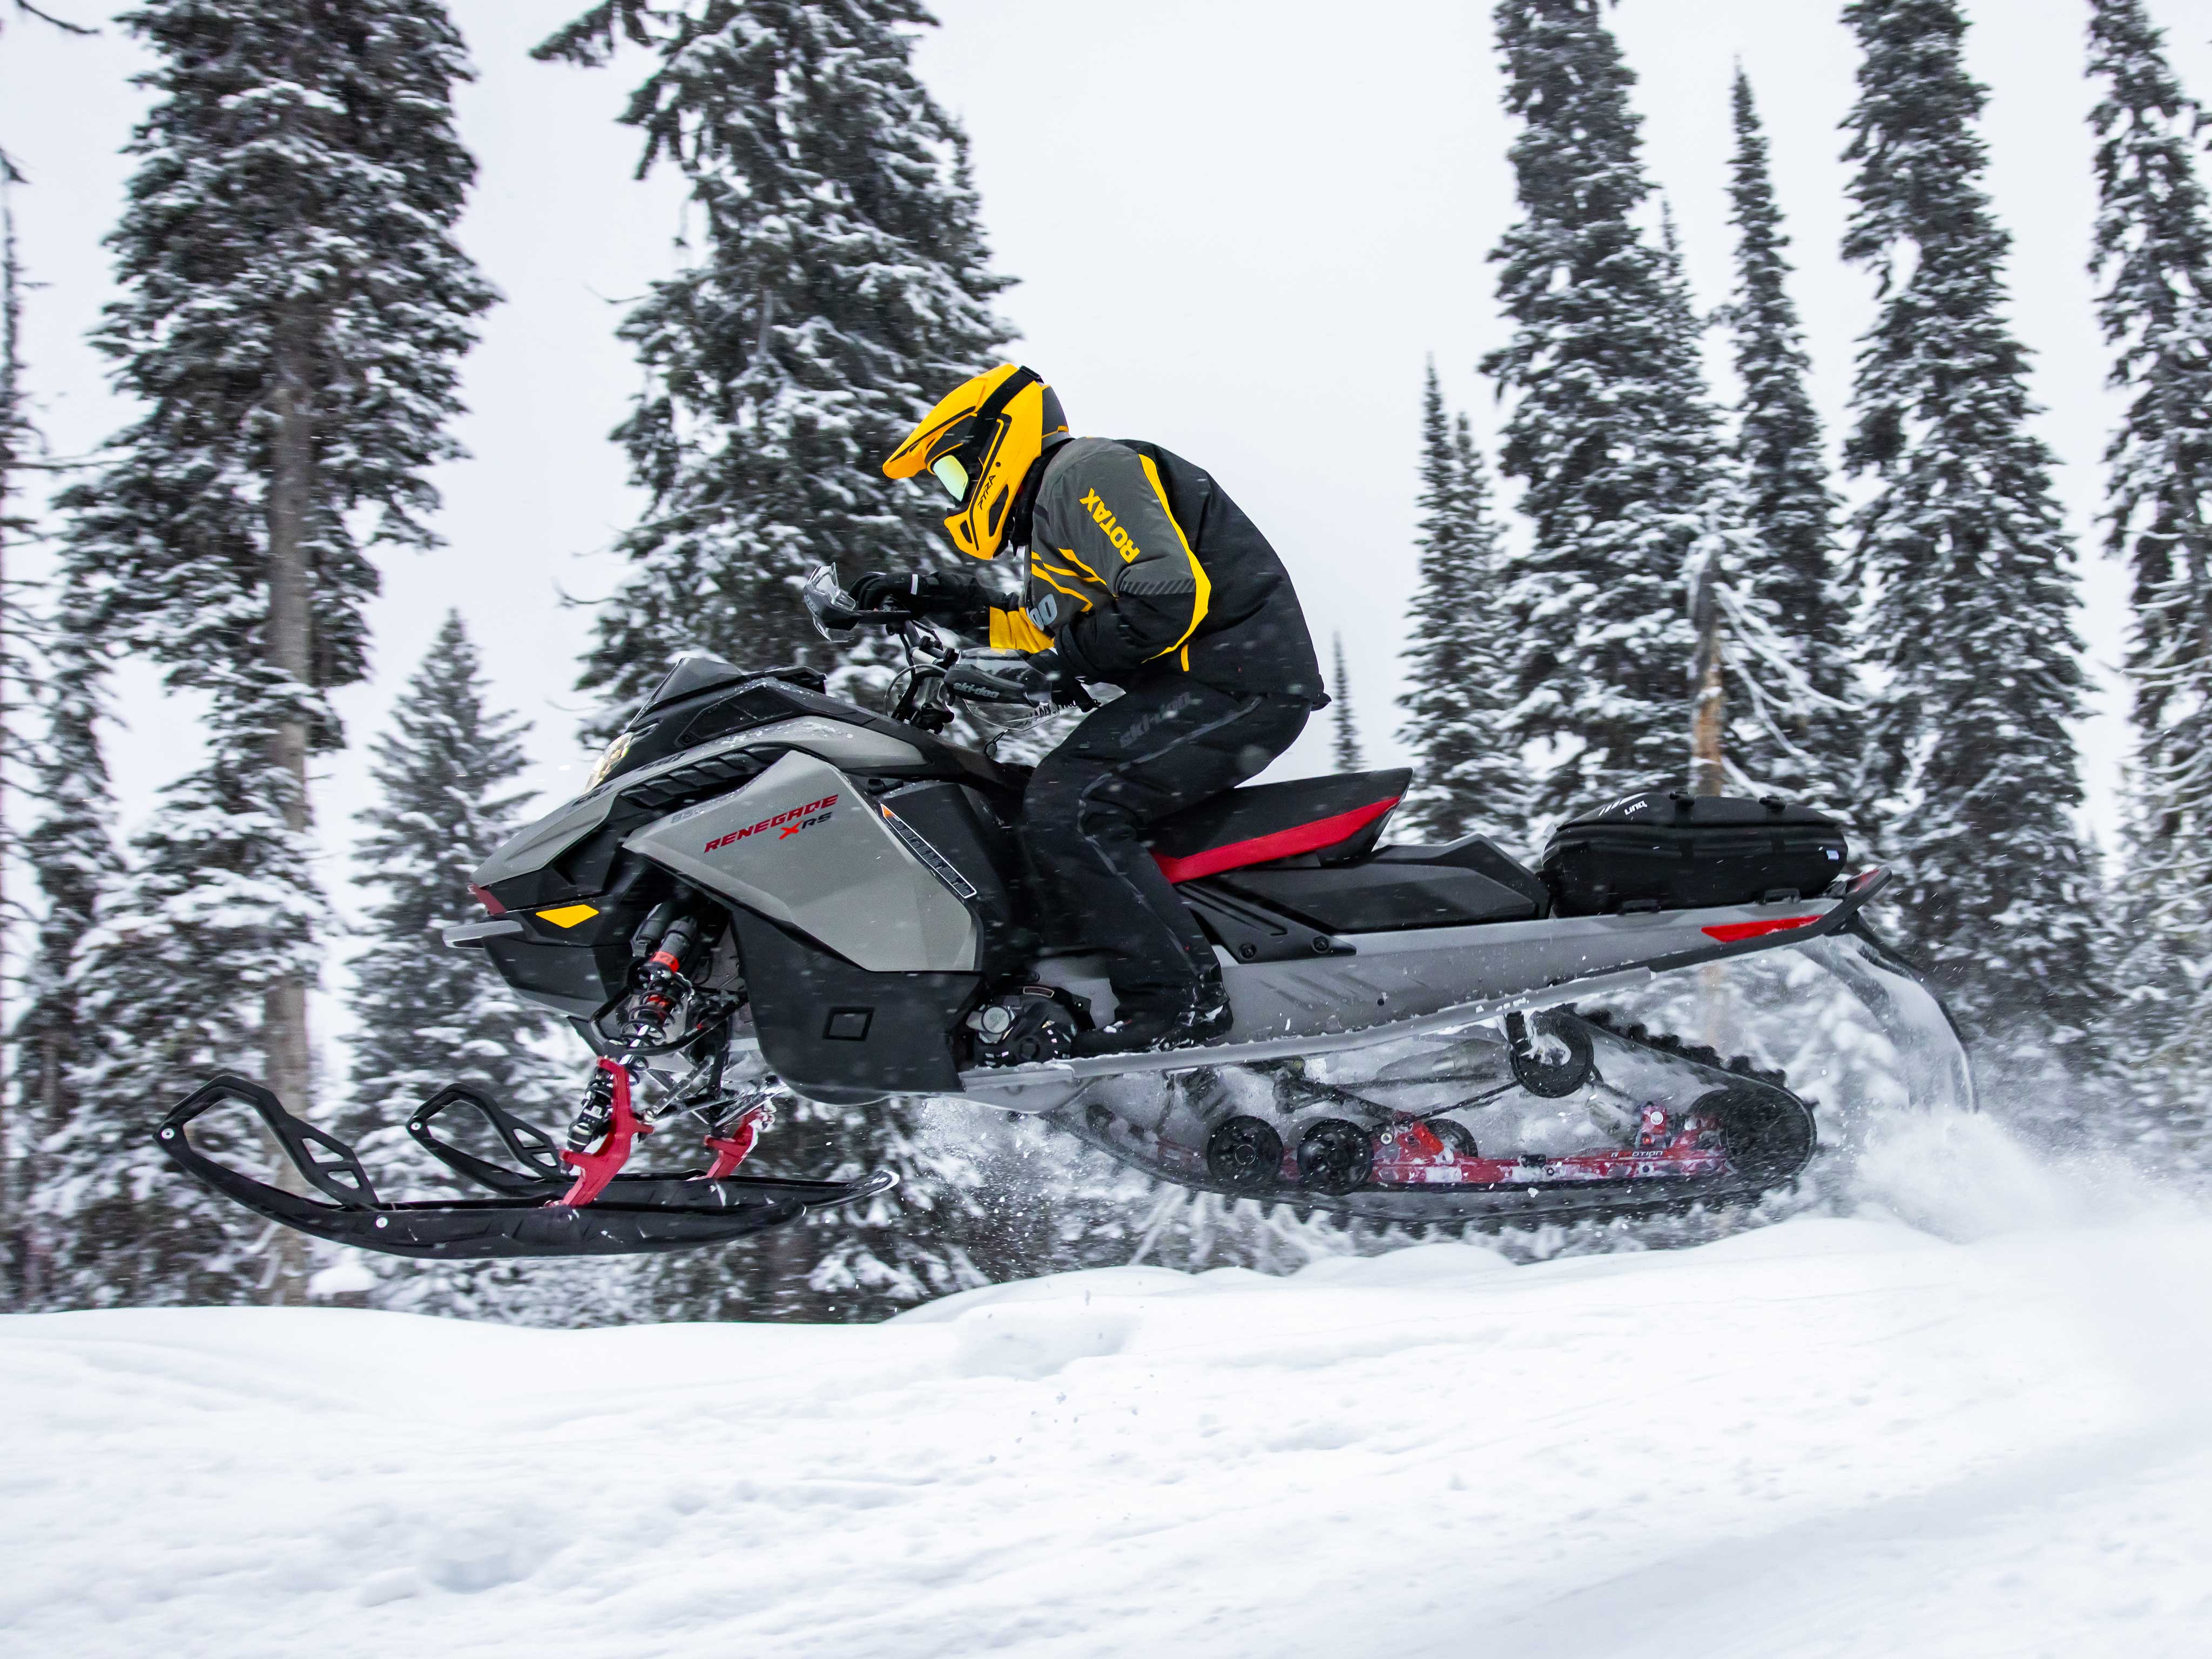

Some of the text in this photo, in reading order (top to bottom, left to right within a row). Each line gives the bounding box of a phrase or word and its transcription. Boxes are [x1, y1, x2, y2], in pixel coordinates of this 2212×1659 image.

[1079, 487, 1140, 563] ROTAX
[953, 682, 1000, 698] ski-doo
[704, 794, 839, 853] RENEGADE
